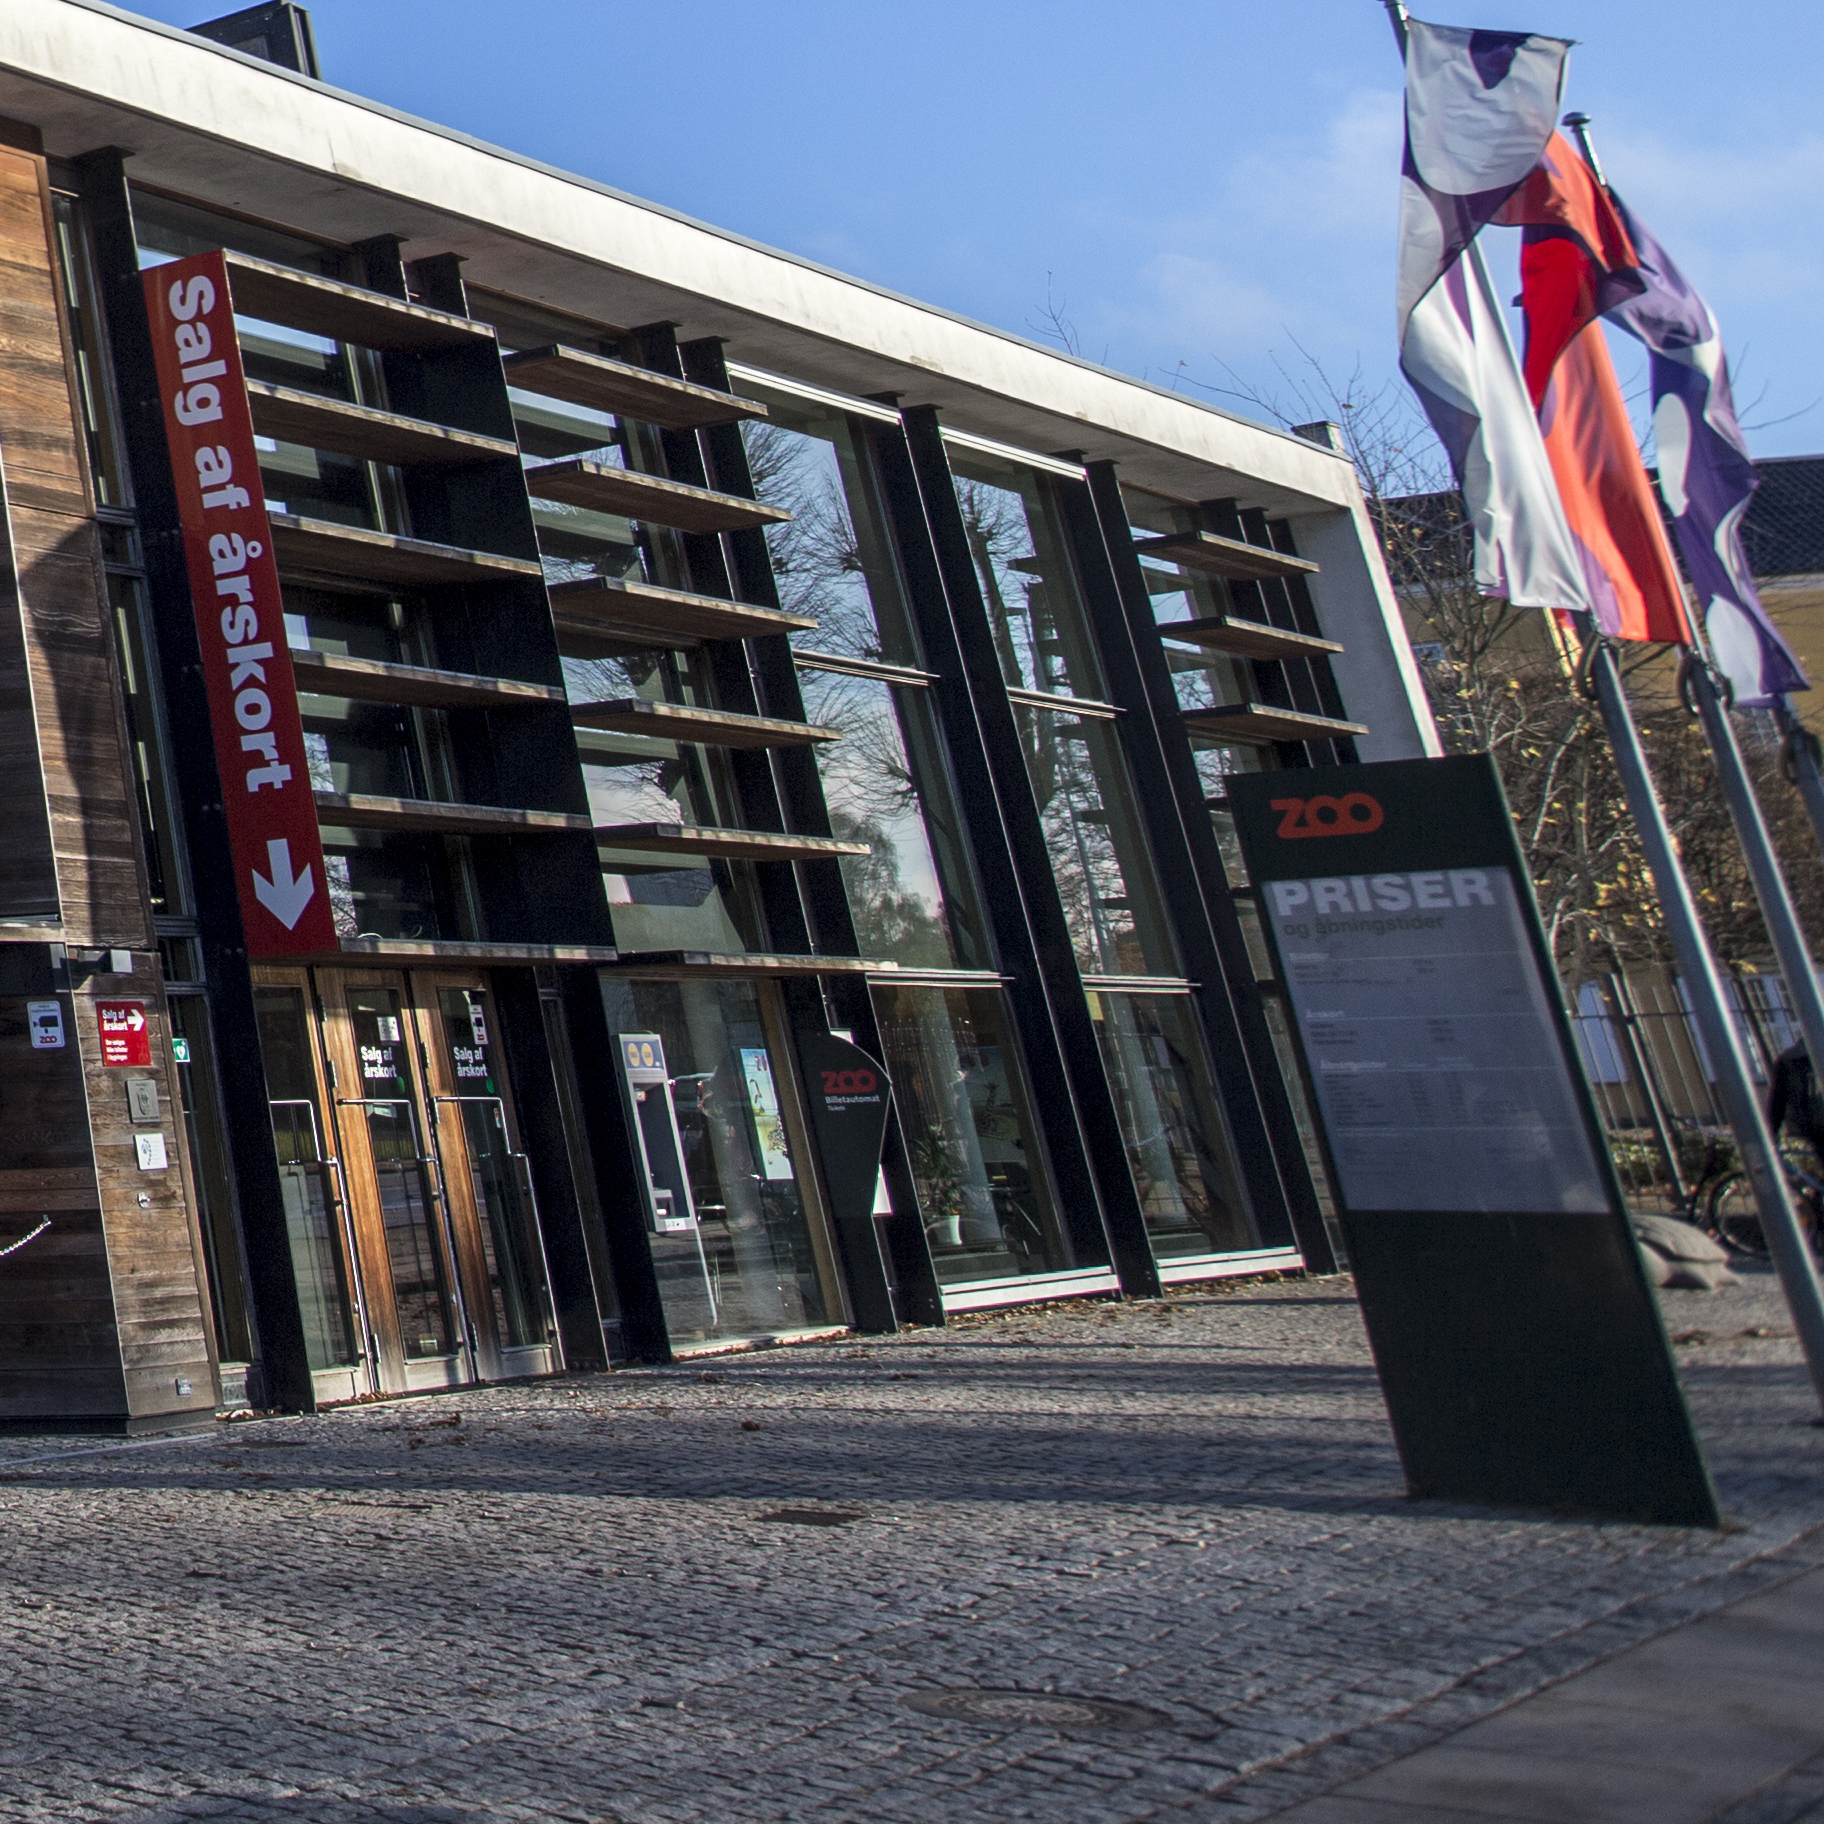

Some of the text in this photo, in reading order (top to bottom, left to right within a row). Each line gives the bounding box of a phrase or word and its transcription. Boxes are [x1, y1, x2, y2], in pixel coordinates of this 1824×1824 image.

[168, 275, 292, 792] Salg af årskort
[1271, 870, 1497, 916] PRISER
[1284, 922, 1310, 939] og
[360, 1046, 393, 1064] Salg af
[453, 1046, 484, 1064] Salg af
[364, 1062, 398, 1078] årskort
[457, 1062, 488, 1077] årskort
[825, 1095, 881, 1104] Billetautomat
